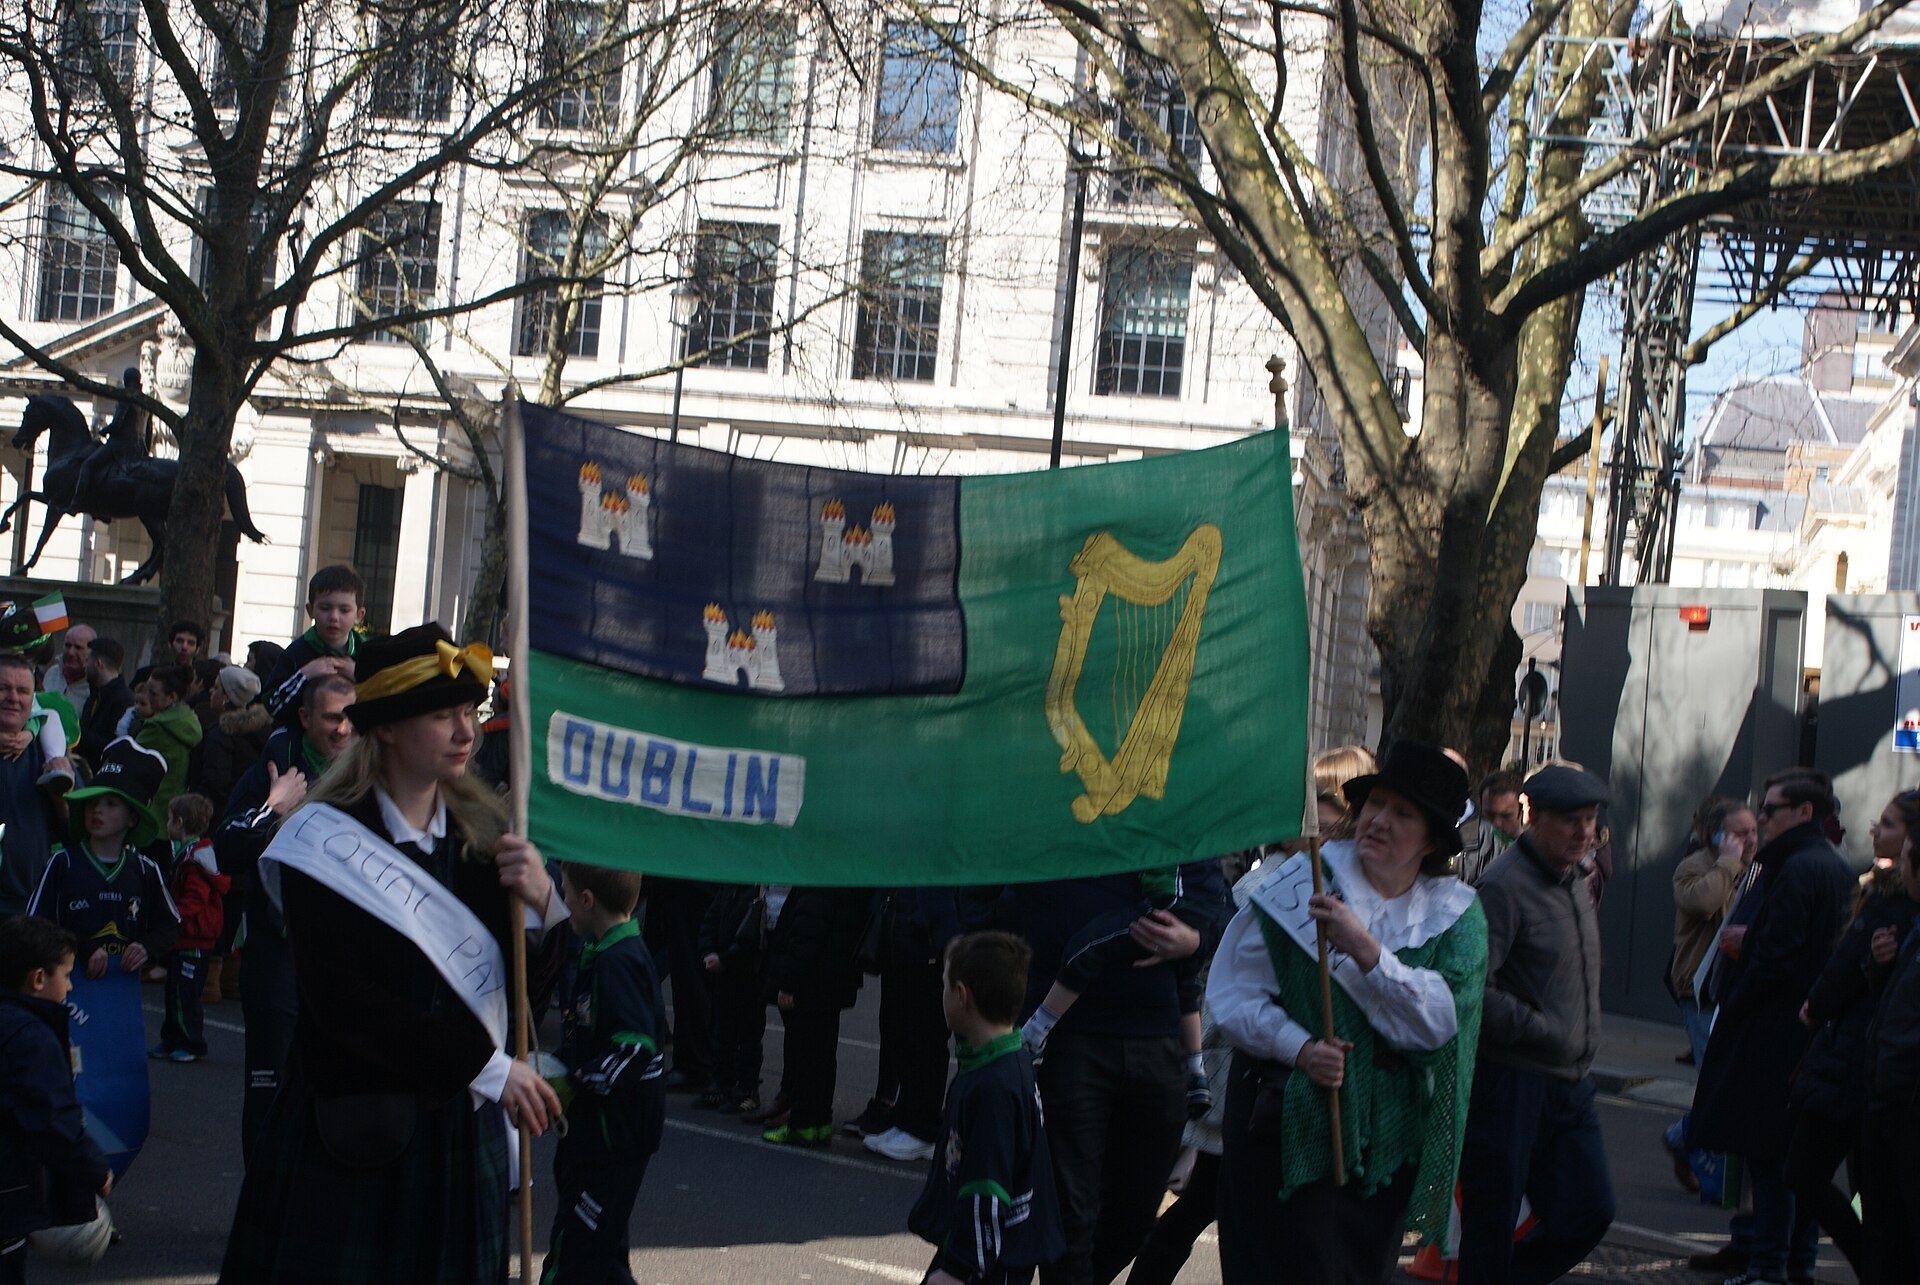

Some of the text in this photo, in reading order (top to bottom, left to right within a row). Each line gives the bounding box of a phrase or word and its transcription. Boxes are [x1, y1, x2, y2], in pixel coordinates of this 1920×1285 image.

[563, 719, 780, 823] DUBLIN
[446, 934, 505, 998] PAY
[66, 1001, 90, 1026] ON
